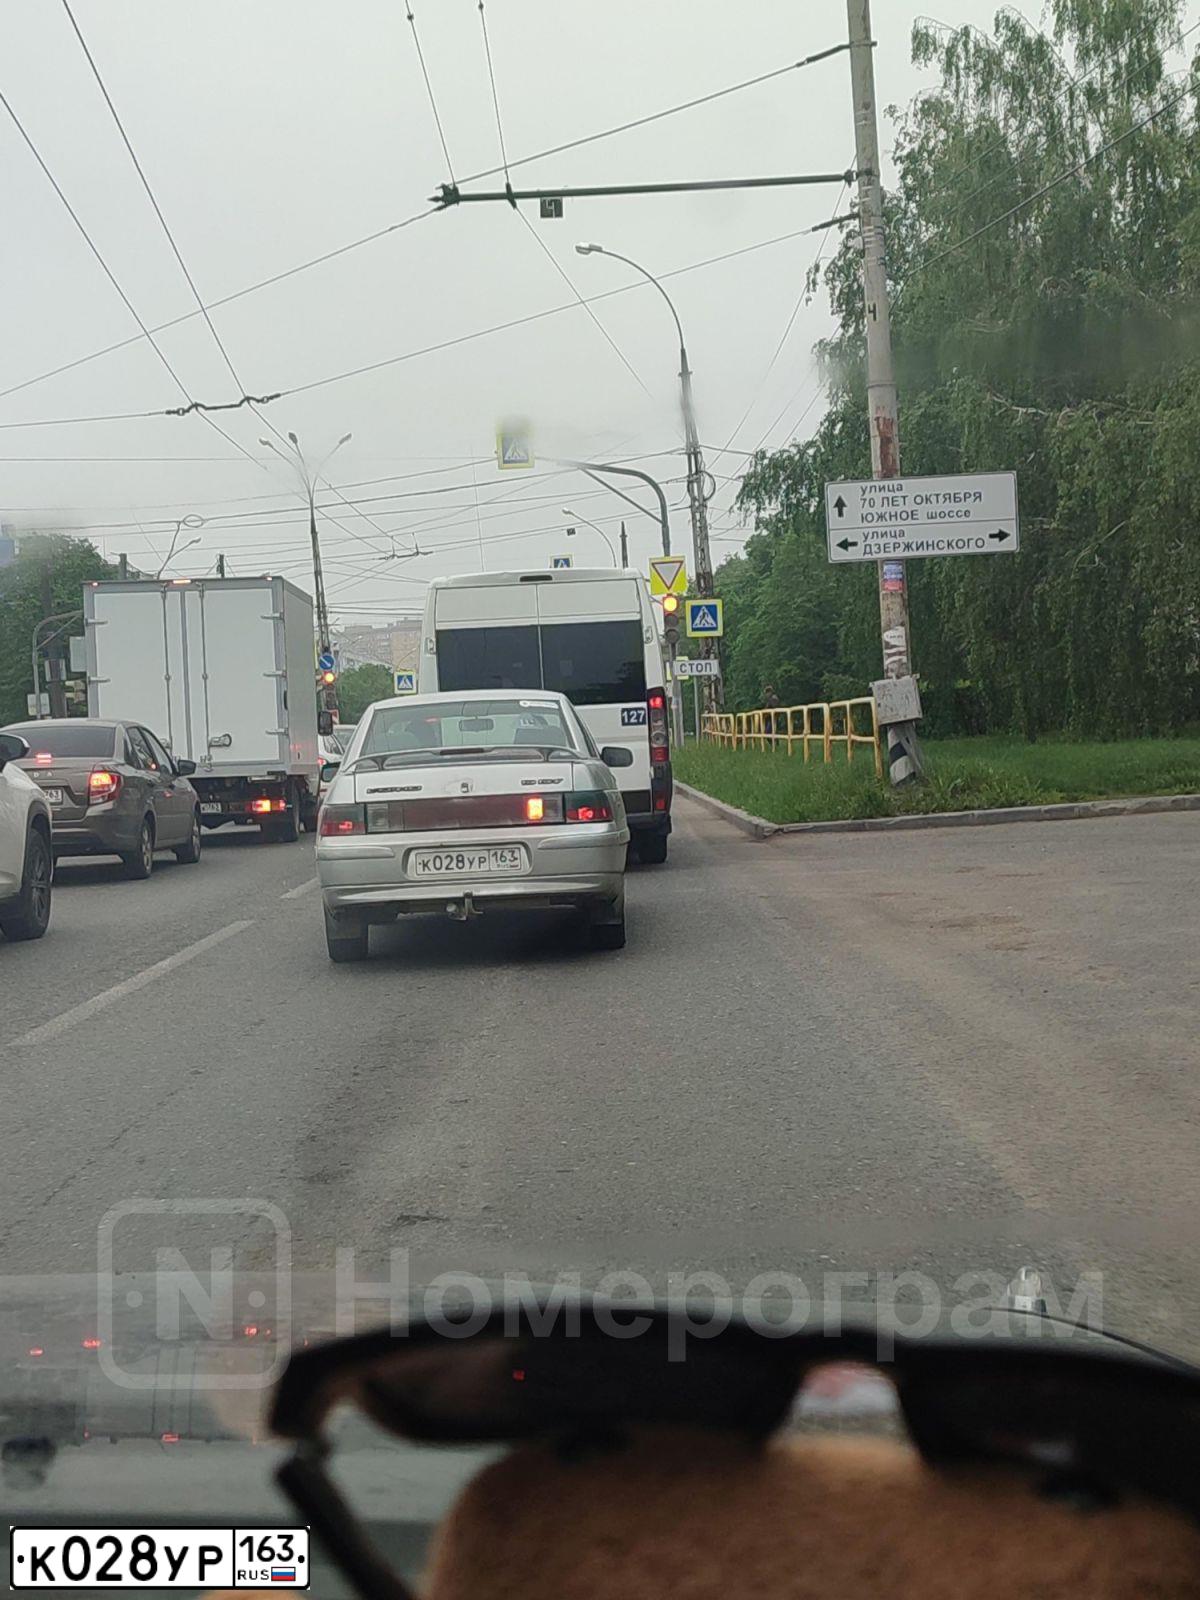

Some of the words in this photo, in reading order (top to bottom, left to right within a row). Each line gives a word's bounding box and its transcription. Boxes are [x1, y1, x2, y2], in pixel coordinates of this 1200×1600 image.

[860, 483, 903, 495] улица
[860, 498, 876, 509] 70
[881, 495, 909, 508] ЛЕТ
[914, 491, 982, 504] ОКТЯБРЯ
[861, 510, 919, 524] ЮЖНОЕ
[927, 509, 971, 520] шоссе
[862, 529, 905, 542] улица
[862, 537, 985, 556] ДЗЕРЖИНСКОГО
[622, 710, 645, 723] 127
[491, 850, 517, 863] 163
